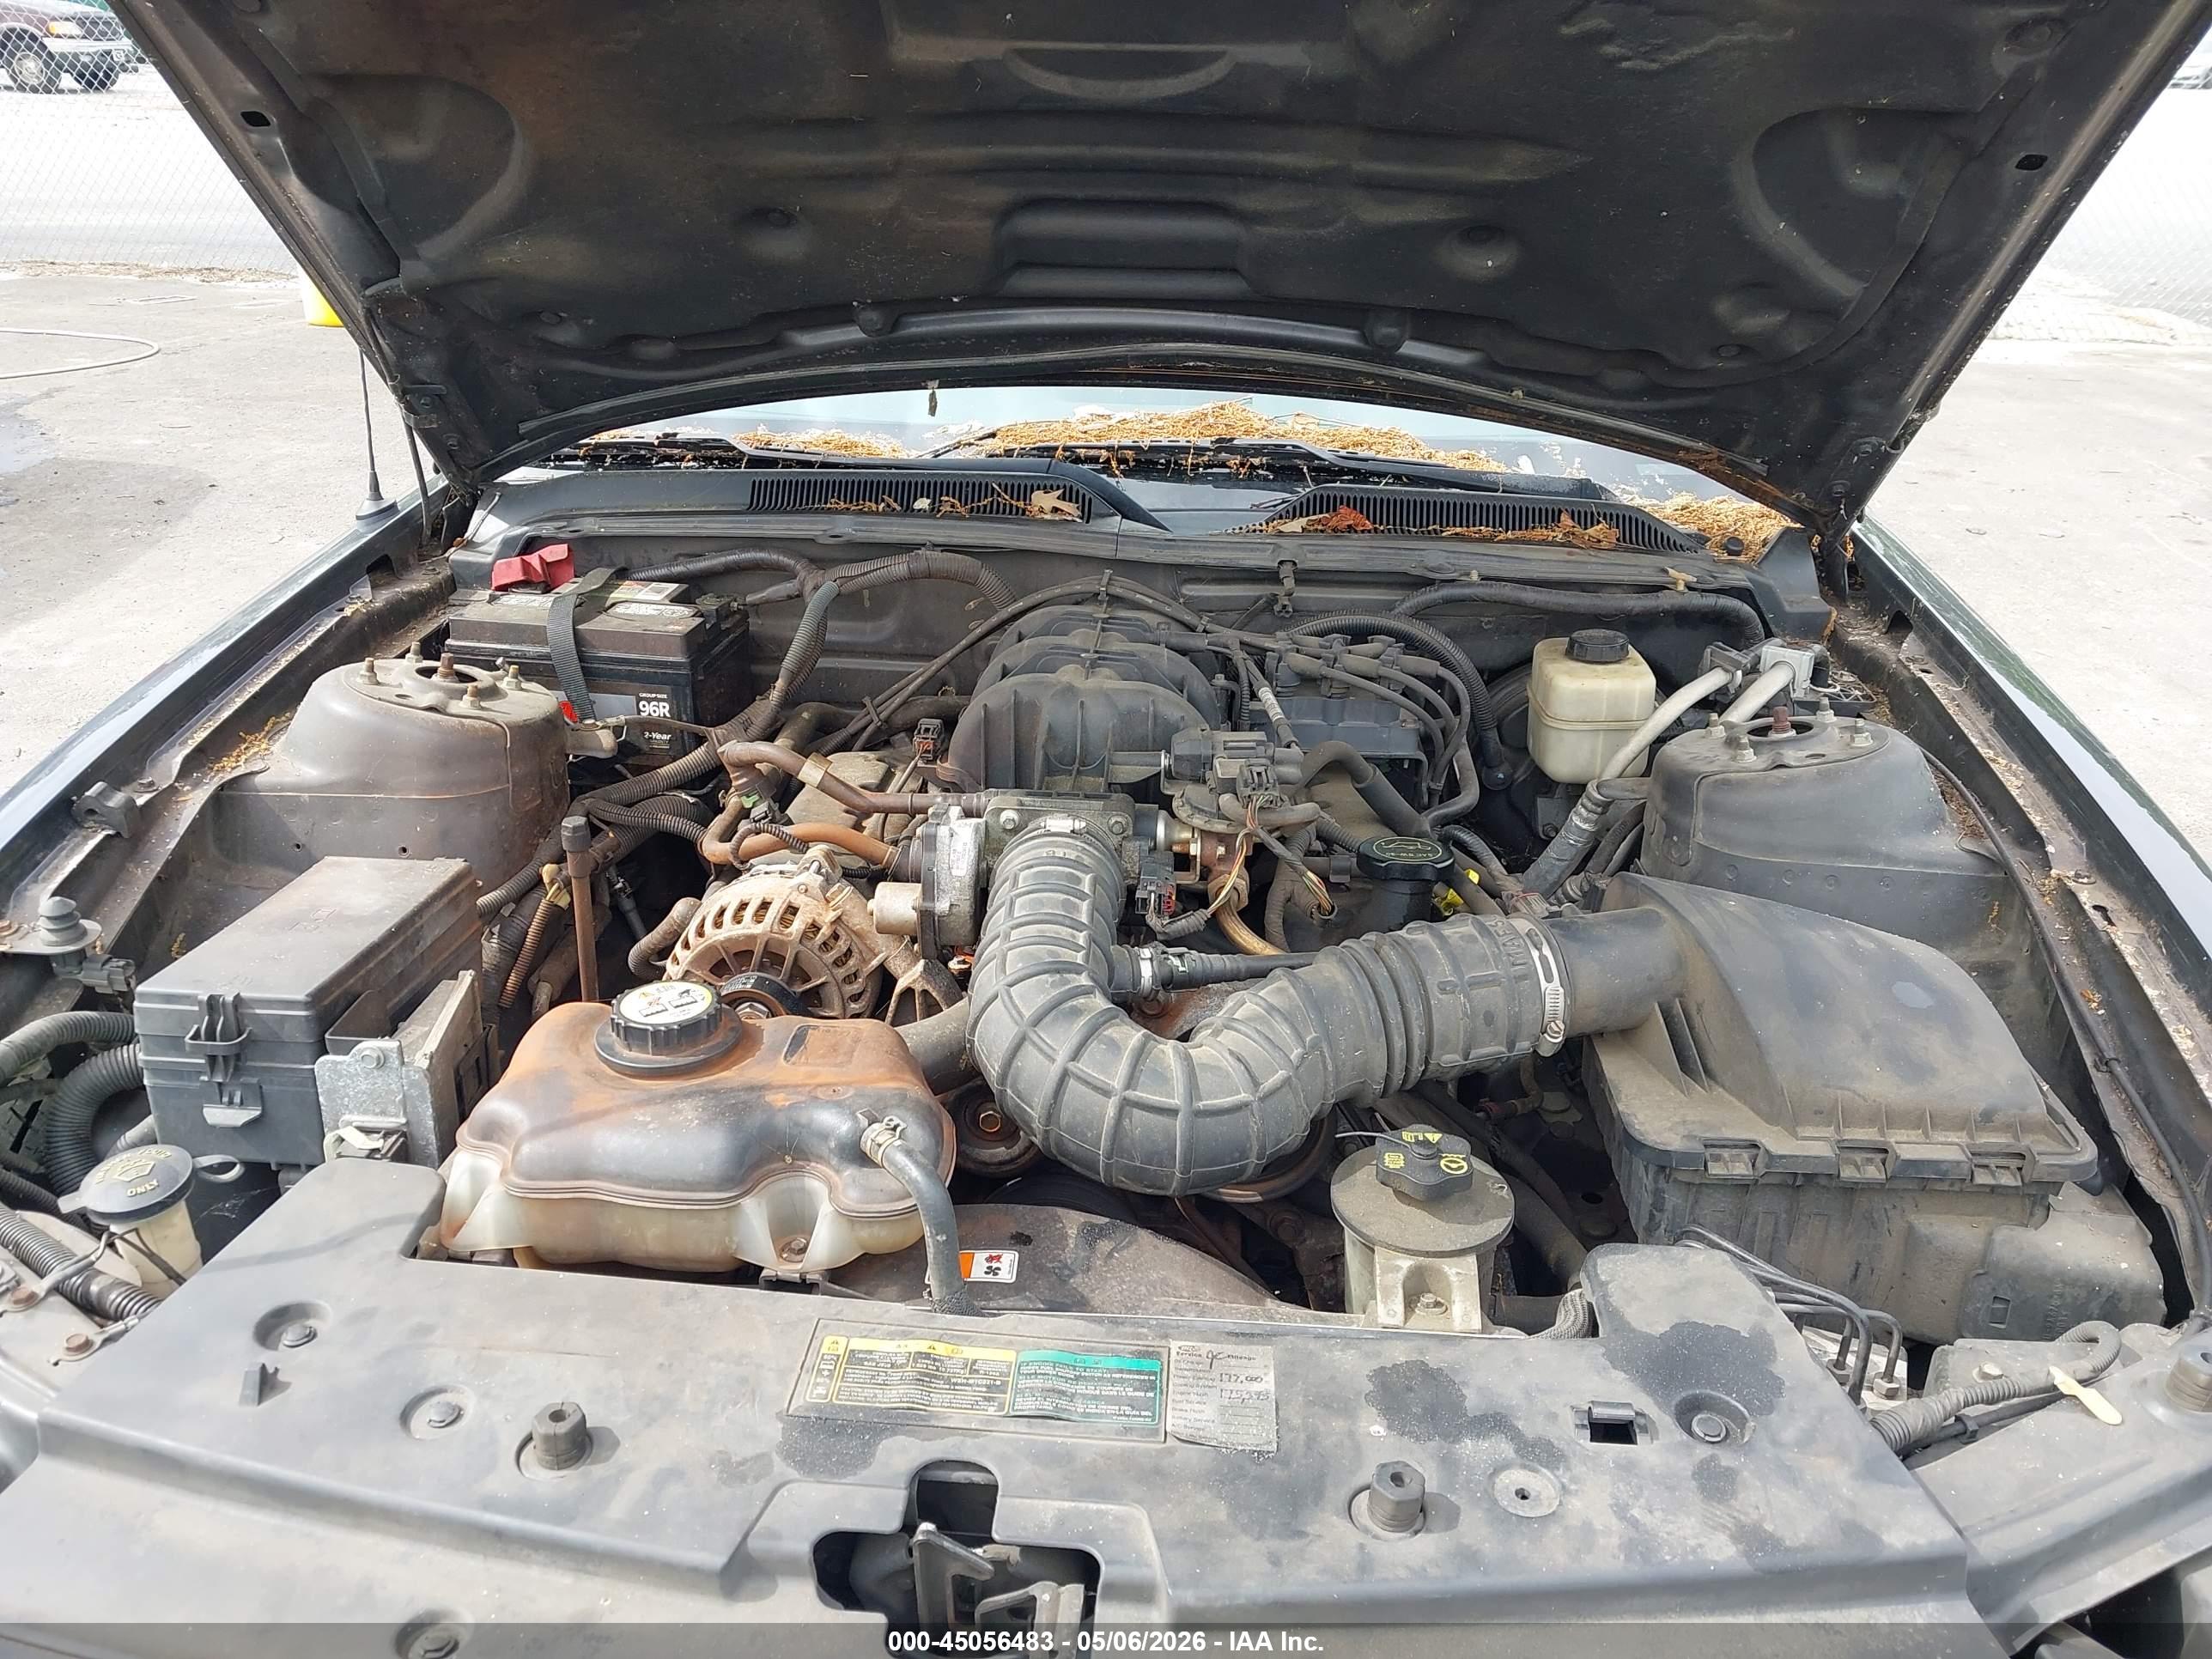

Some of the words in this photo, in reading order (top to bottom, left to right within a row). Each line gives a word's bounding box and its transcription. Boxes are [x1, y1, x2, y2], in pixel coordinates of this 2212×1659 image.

[638, 700, 671, 717] 96R
[644, 731, 672, 741] 2-Year
[127, 1179, 160, 1197] ONLY
